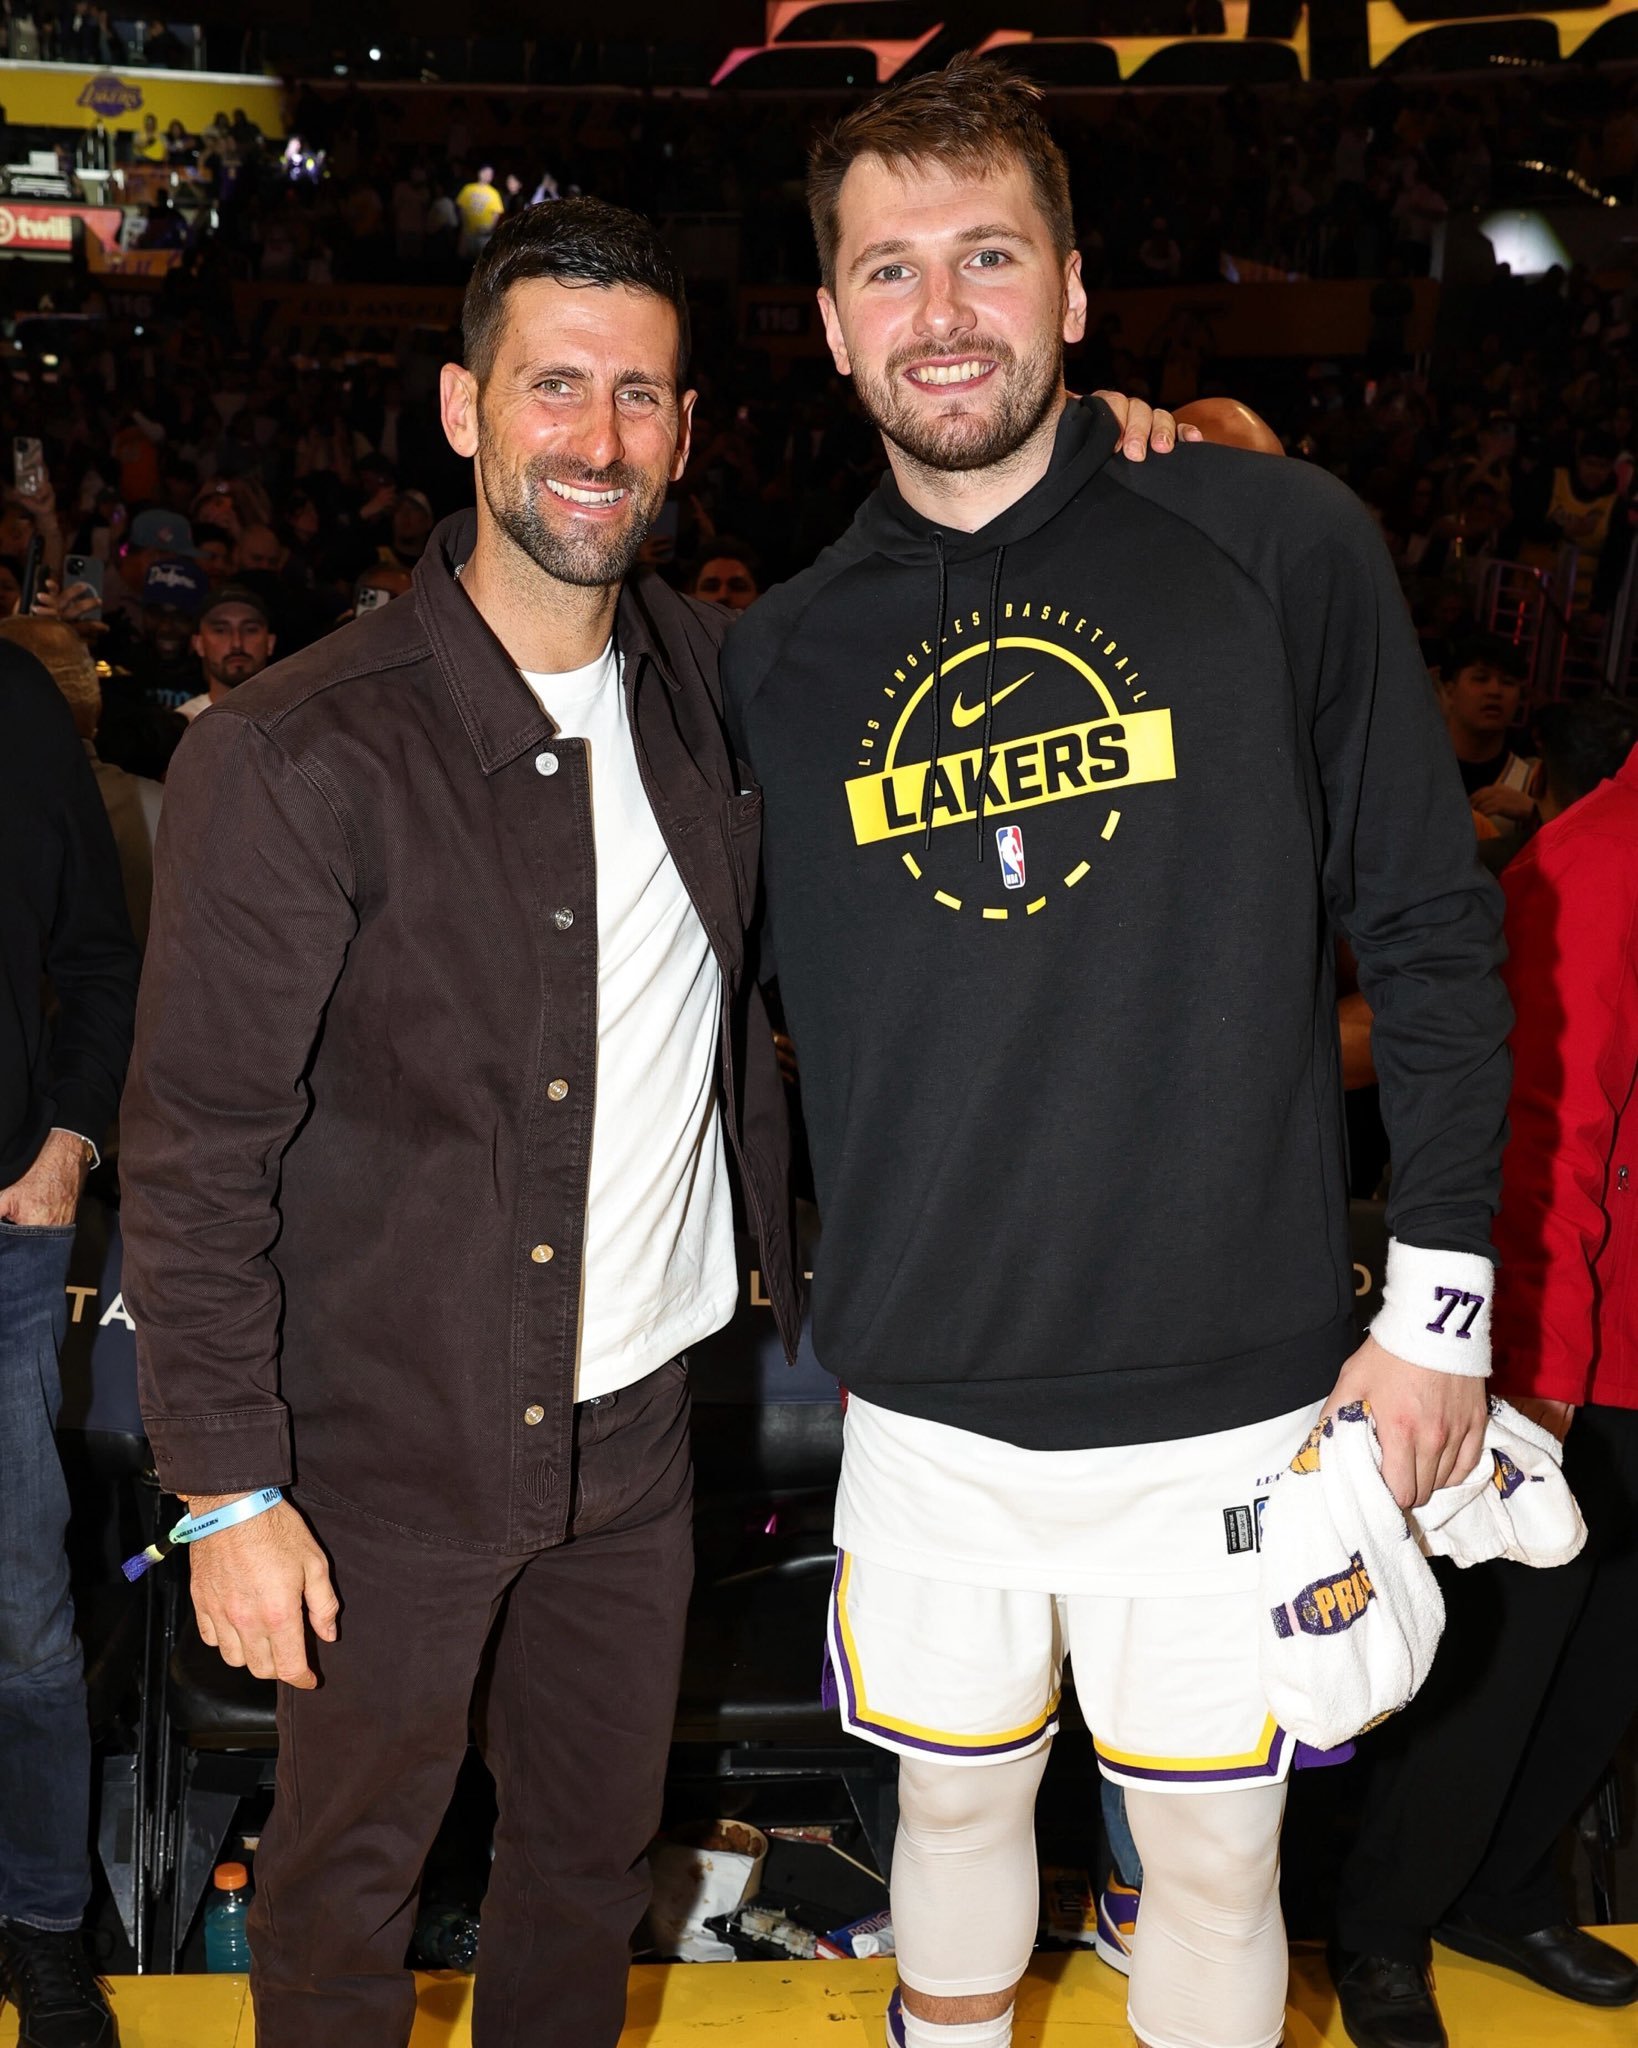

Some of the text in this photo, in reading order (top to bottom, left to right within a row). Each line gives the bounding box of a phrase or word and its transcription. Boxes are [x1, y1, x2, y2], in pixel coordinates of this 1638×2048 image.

[858, 602, 1147, 766] LOS ANGEES BASKETBALL
[881, 723, 1130, 830] LAKERS
[1426, 1286, 1484, 1339] 77
